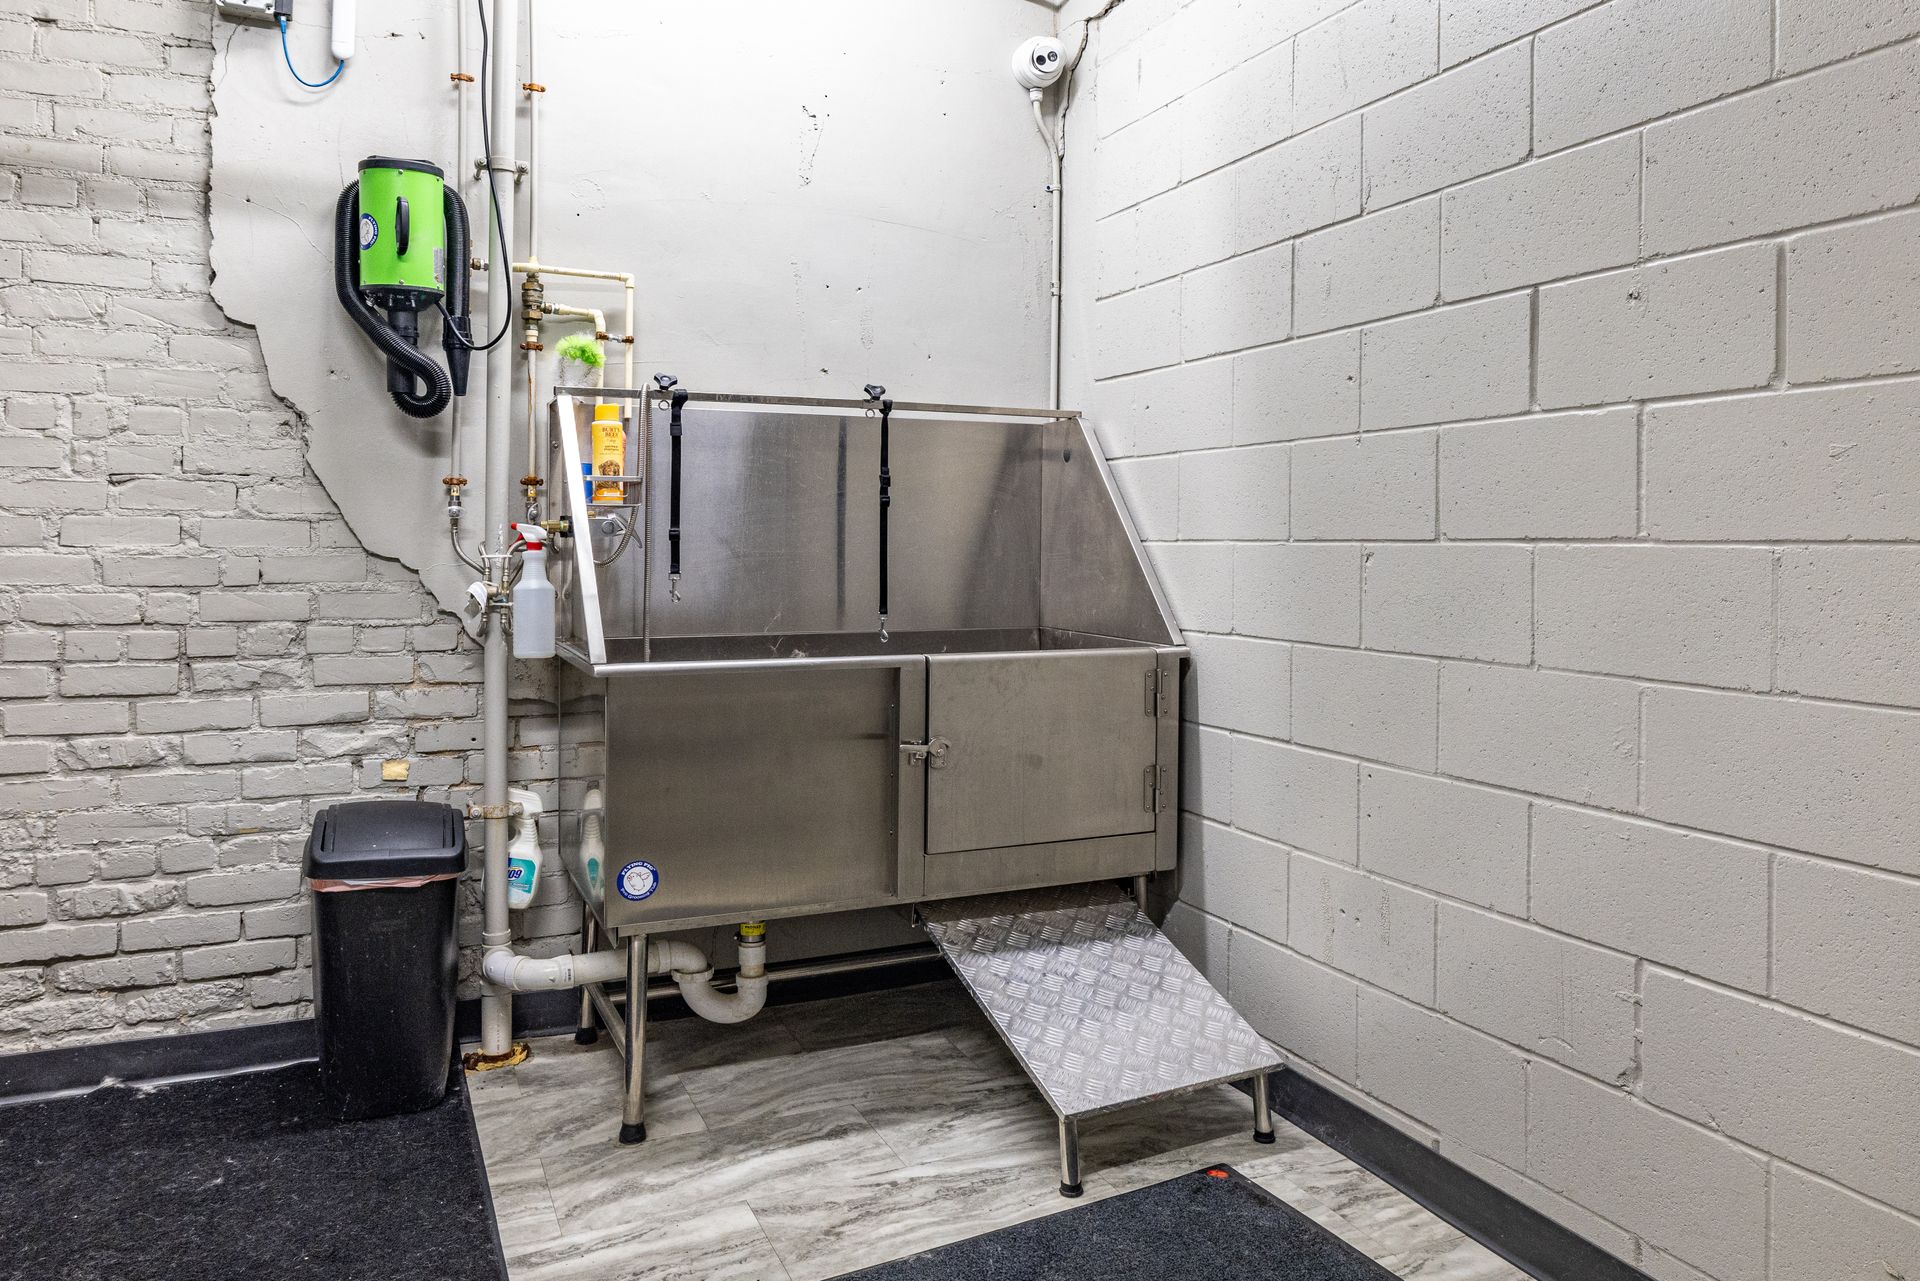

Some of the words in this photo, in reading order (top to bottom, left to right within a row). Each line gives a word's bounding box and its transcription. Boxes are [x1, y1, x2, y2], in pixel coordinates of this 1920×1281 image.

[508, 869, 523, 879] 09
[621, 862, 643, 875] FLYING
[643, 862, 655, 871] PIG
